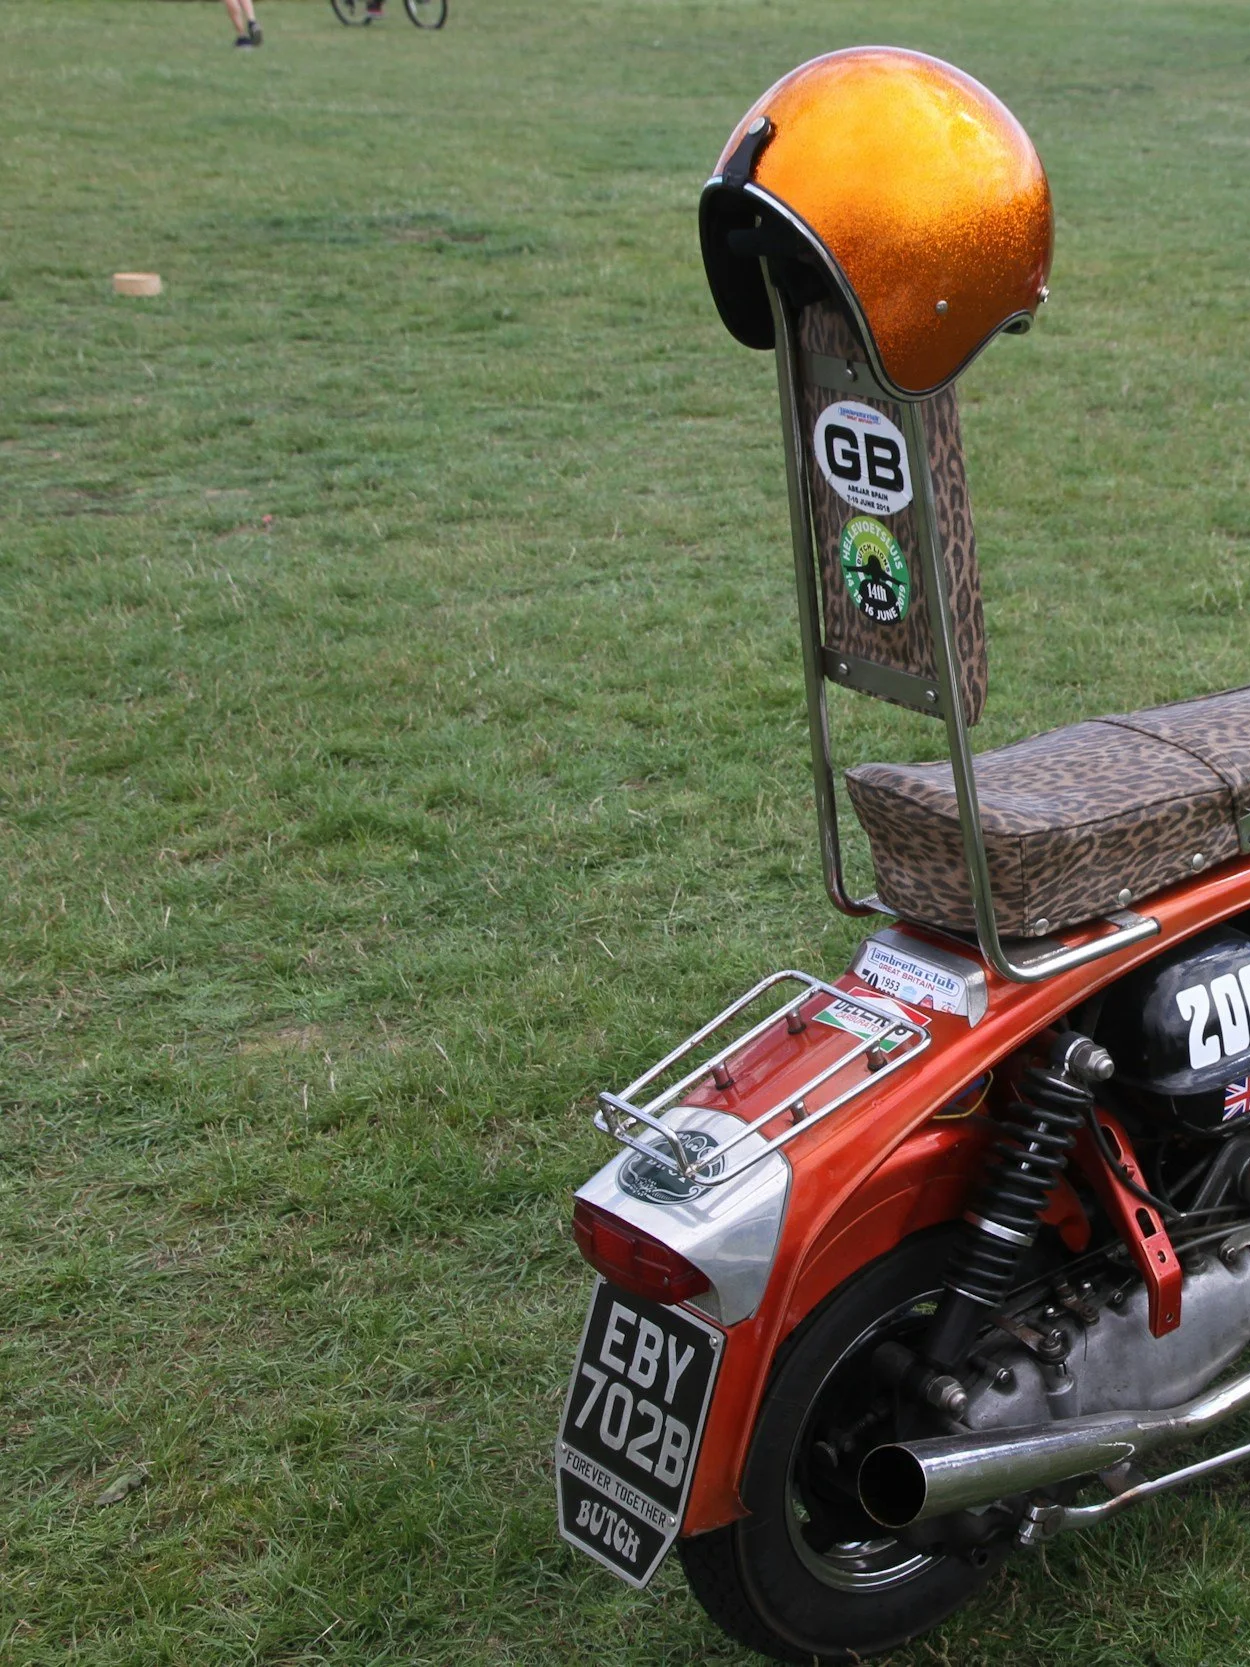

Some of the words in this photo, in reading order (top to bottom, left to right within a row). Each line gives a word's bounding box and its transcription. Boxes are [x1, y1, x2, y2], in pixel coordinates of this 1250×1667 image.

[825, 423, 904, 493] GB
[847, 484, 871, 496] ABEJAR
[871, 490, 889, 501] SPAIN
[860, 499, 876, 509] JUNE
[842, 521, 903, 570] HELLEVOETSLUIS
[856, 545, 872, 565] DUTCH
[873, 547, 890, 572] LIONS
[864, 602, 874, 617] 16
[876, 608, 898, 622] JUNE
[895, 584, 906, 613] 2019
[866, 582, 888, 603] 14th
[870, 946, 923, 977] Lambretta
[924, 972, 955, 990] club
[878, 962, 902, 976] GREAT
[901, 971, 936, 991] BRITAIN
[881, 976, 900, 992] 1953
[599, 1300, 695, 1406] EBY
[574, 1362, 691, 1489] 702B
[565, 1452, 612, 1492] FOREVER
[614, 1481, 667, 1528] TOGETHER
[575, 1499, 641, 1564] BUTCH
